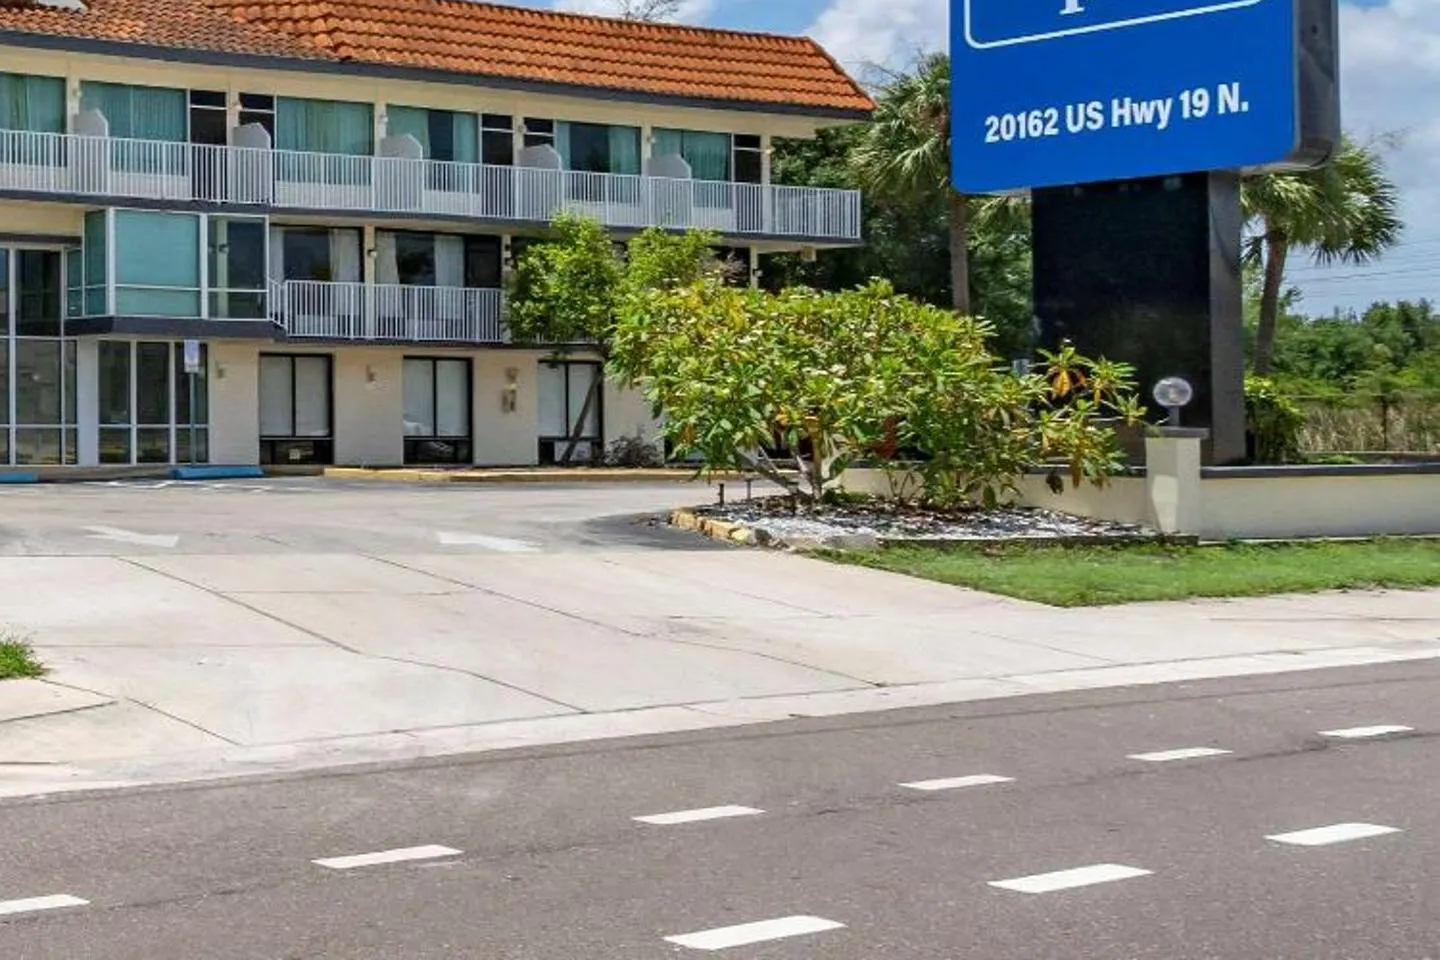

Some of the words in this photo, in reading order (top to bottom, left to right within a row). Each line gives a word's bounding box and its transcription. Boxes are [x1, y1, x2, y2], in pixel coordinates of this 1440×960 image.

[984, 109, 1059, 143] 20162
[1065, 100, 1105, 134] US
[1111, 97, 1173, 130] Hwy
[1179, 87, 1210, 119] 19
[1217, 82, 1249, 115] N.
